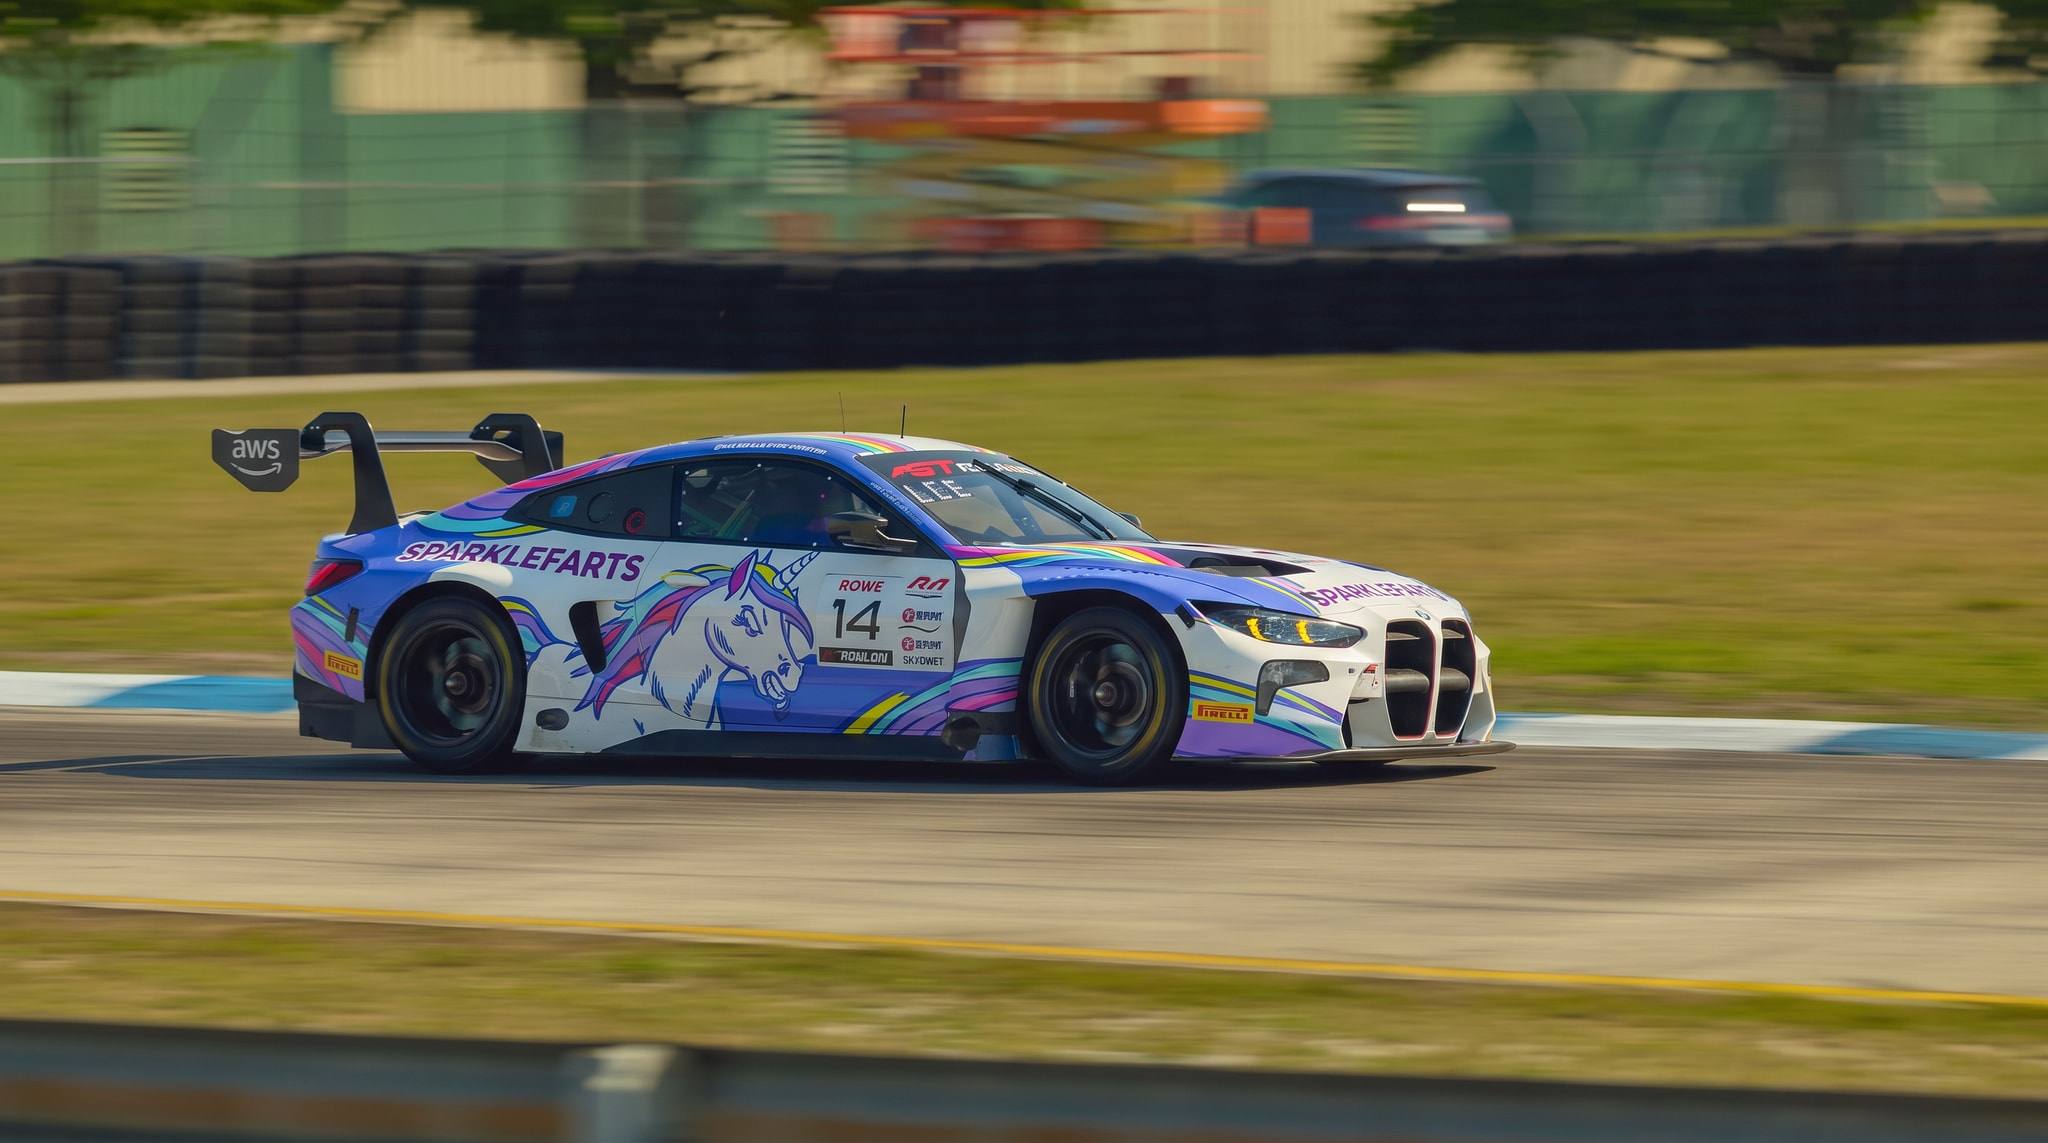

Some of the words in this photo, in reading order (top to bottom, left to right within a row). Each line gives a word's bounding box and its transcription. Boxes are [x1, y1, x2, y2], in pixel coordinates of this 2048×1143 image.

[232, 439, 281, 460] aws
[903, 479, 973, 504] LEE
[398, 542, 646, 583] SPARKLEFARTS
[838, 579, 885, 593] ROWE
[832, 598, 882, 640] 14
[1197, 704, 1249, 720] PIRELLI
